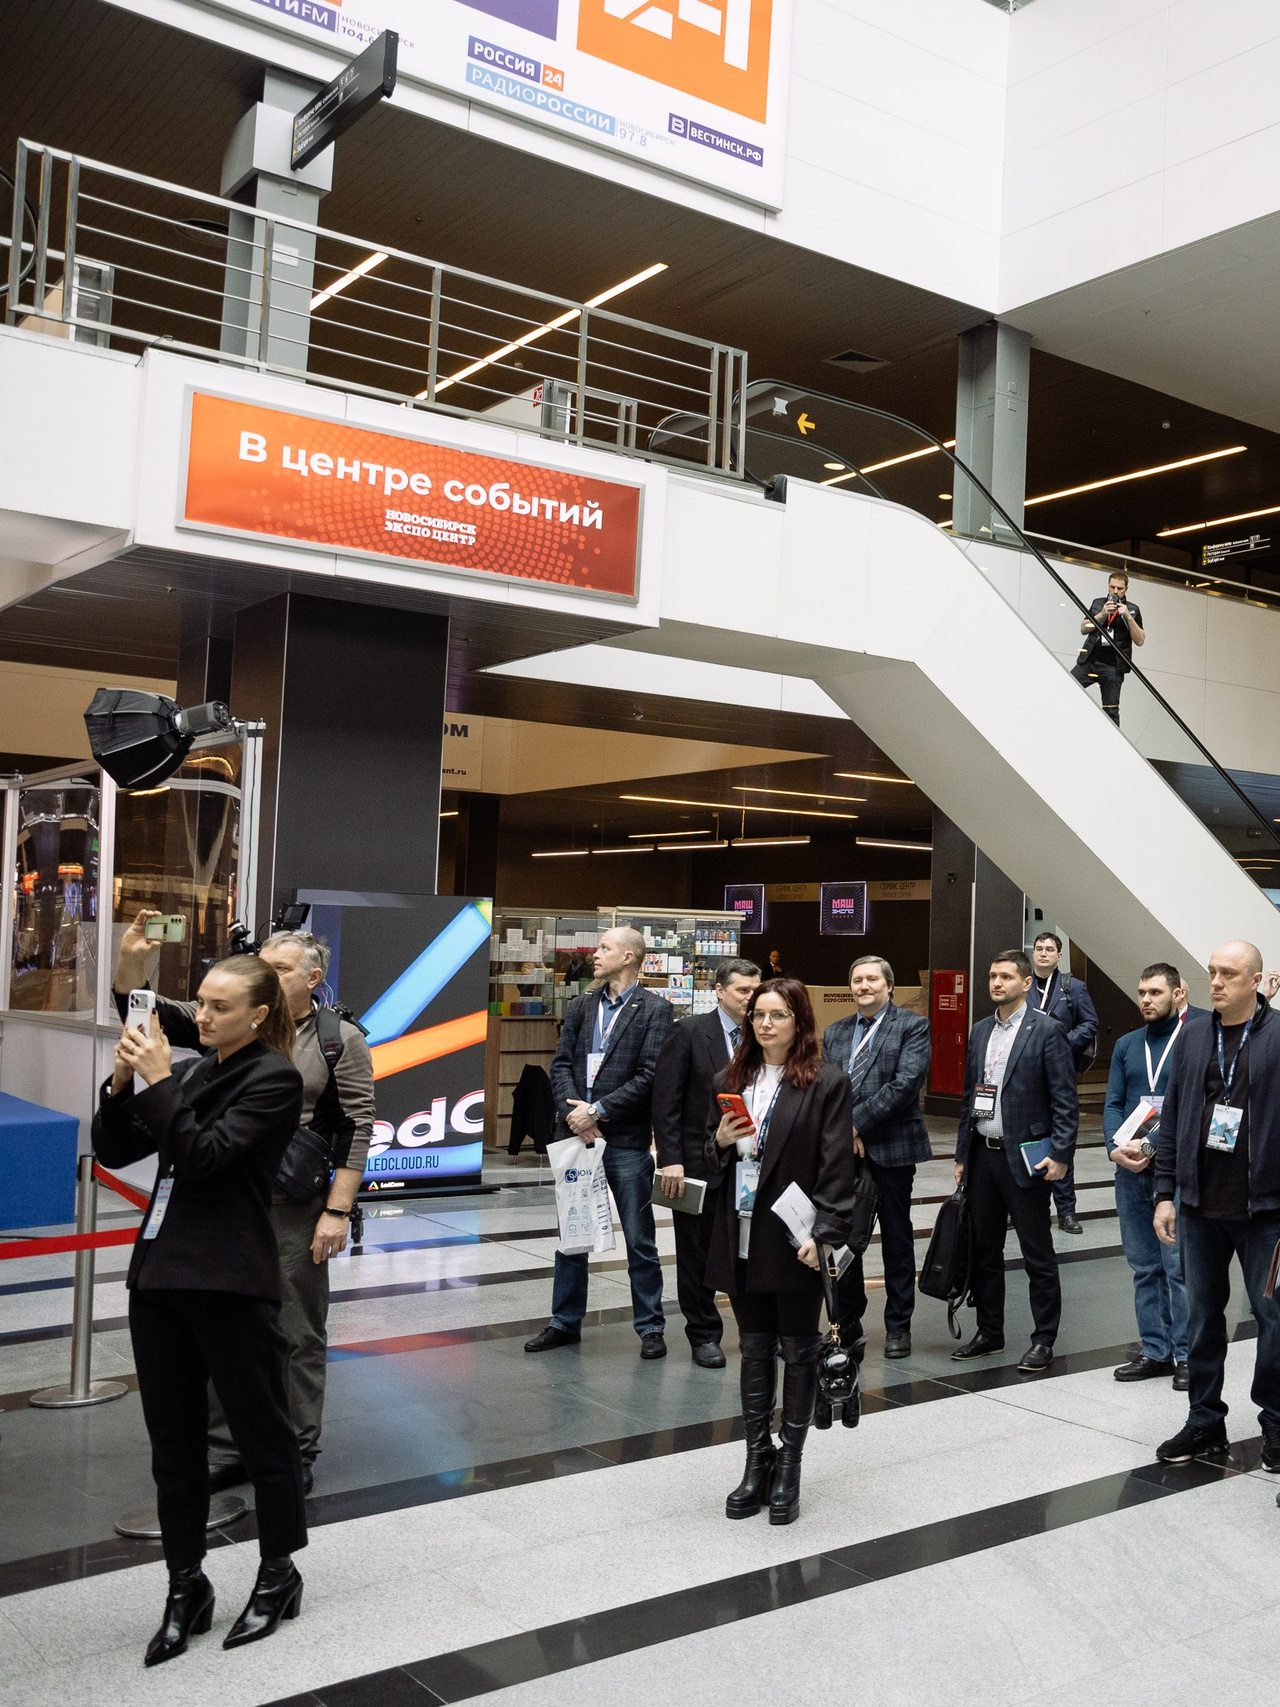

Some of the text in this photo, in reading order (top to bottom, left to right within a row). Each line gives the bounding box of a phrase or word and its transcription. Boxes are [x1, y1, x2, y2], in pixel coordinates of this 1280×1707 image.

[341, 26, 375, 45] 104.6
[342, 16, 416, 49] НОВОСИРСК
[474, 41, 563, 89] РОССИЯ 24
[471, 67, 612, 132] РАДИОРОССИИ
[619, 121, 676, 147] НОВОСИБИРСК
[619, 128, 647, 147] 97.8
[690, 127, 763, 163] ВЕСТИНСК.РФ
[238, 430, 604, 530] В центре событий
[385, 509, 477, 535] НОВОСИБИРСК
[880, 882, 916, 891] СЕРВИС ЦЕНТР
[734, 900, 753, 909] МАШ
[832, 898, 854, 909] МАШ
[367, 1090, 485, 1158] edC
[368, 1155, 439, 1171] LEDCLOUD.RU
